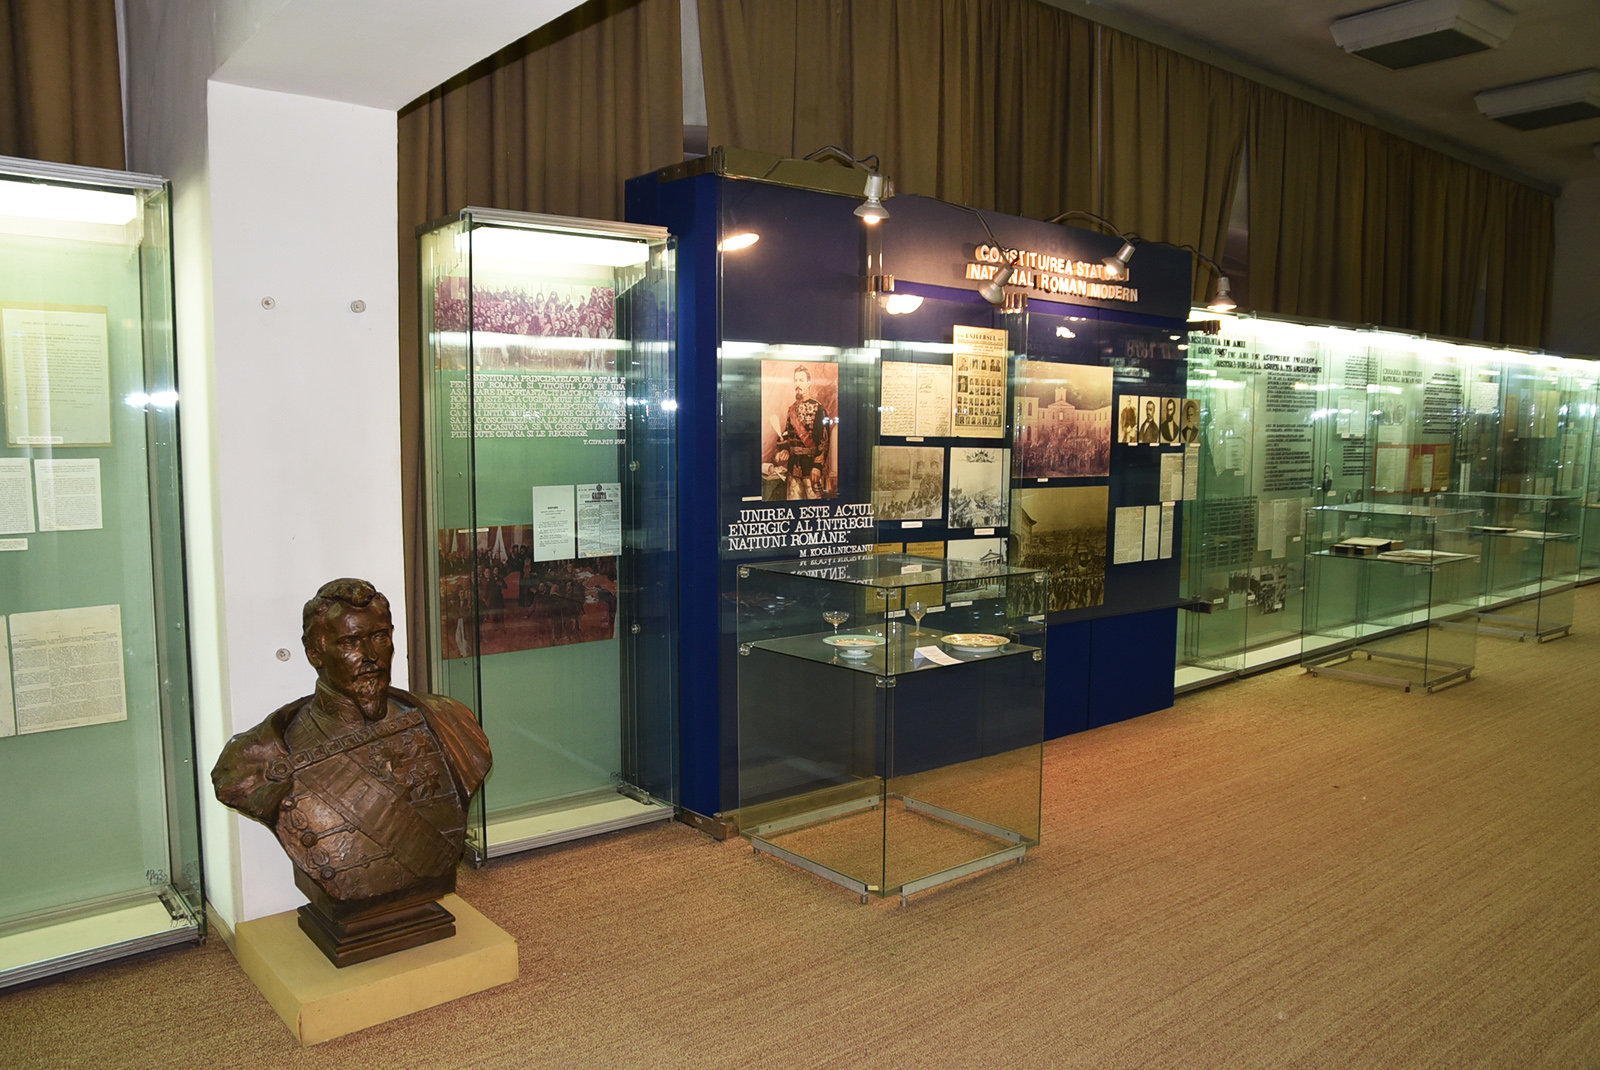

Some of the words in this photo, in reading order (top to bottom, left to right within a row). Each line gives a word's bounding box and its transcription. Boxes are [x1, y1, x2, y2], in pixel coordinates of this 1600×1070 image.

[1074, 261, 1129, 281] STATI
[966, 264, 1034, 287] NATNAL
[1088, 283, 1138, 302] MODERN
[521, 375, 580, 383] PRINCIPATELOR
[489, 381, 522, 389] ROMANI
[611, 383, 626, 391] UNA
[523, 396, 552, 404] CUGETA
[554, 396, 571, 404] MULT
[484, 423, 529, 431] OCASIUNEA
[496, 430, 514, 438] CUM
[515, 430, 525, 438] SA
[536, 430, 546, 438] LE
[800, 506, 830, 519] ESTE
[834, 503, 874, 517] ACTUL
[728, 521, 790, 537] ENERGIC
[794, 520, 813, 533] AL
[817, 517, 874, 531] ÎNTREGII
[728, 534, 787, 552] NAȚIUNI
